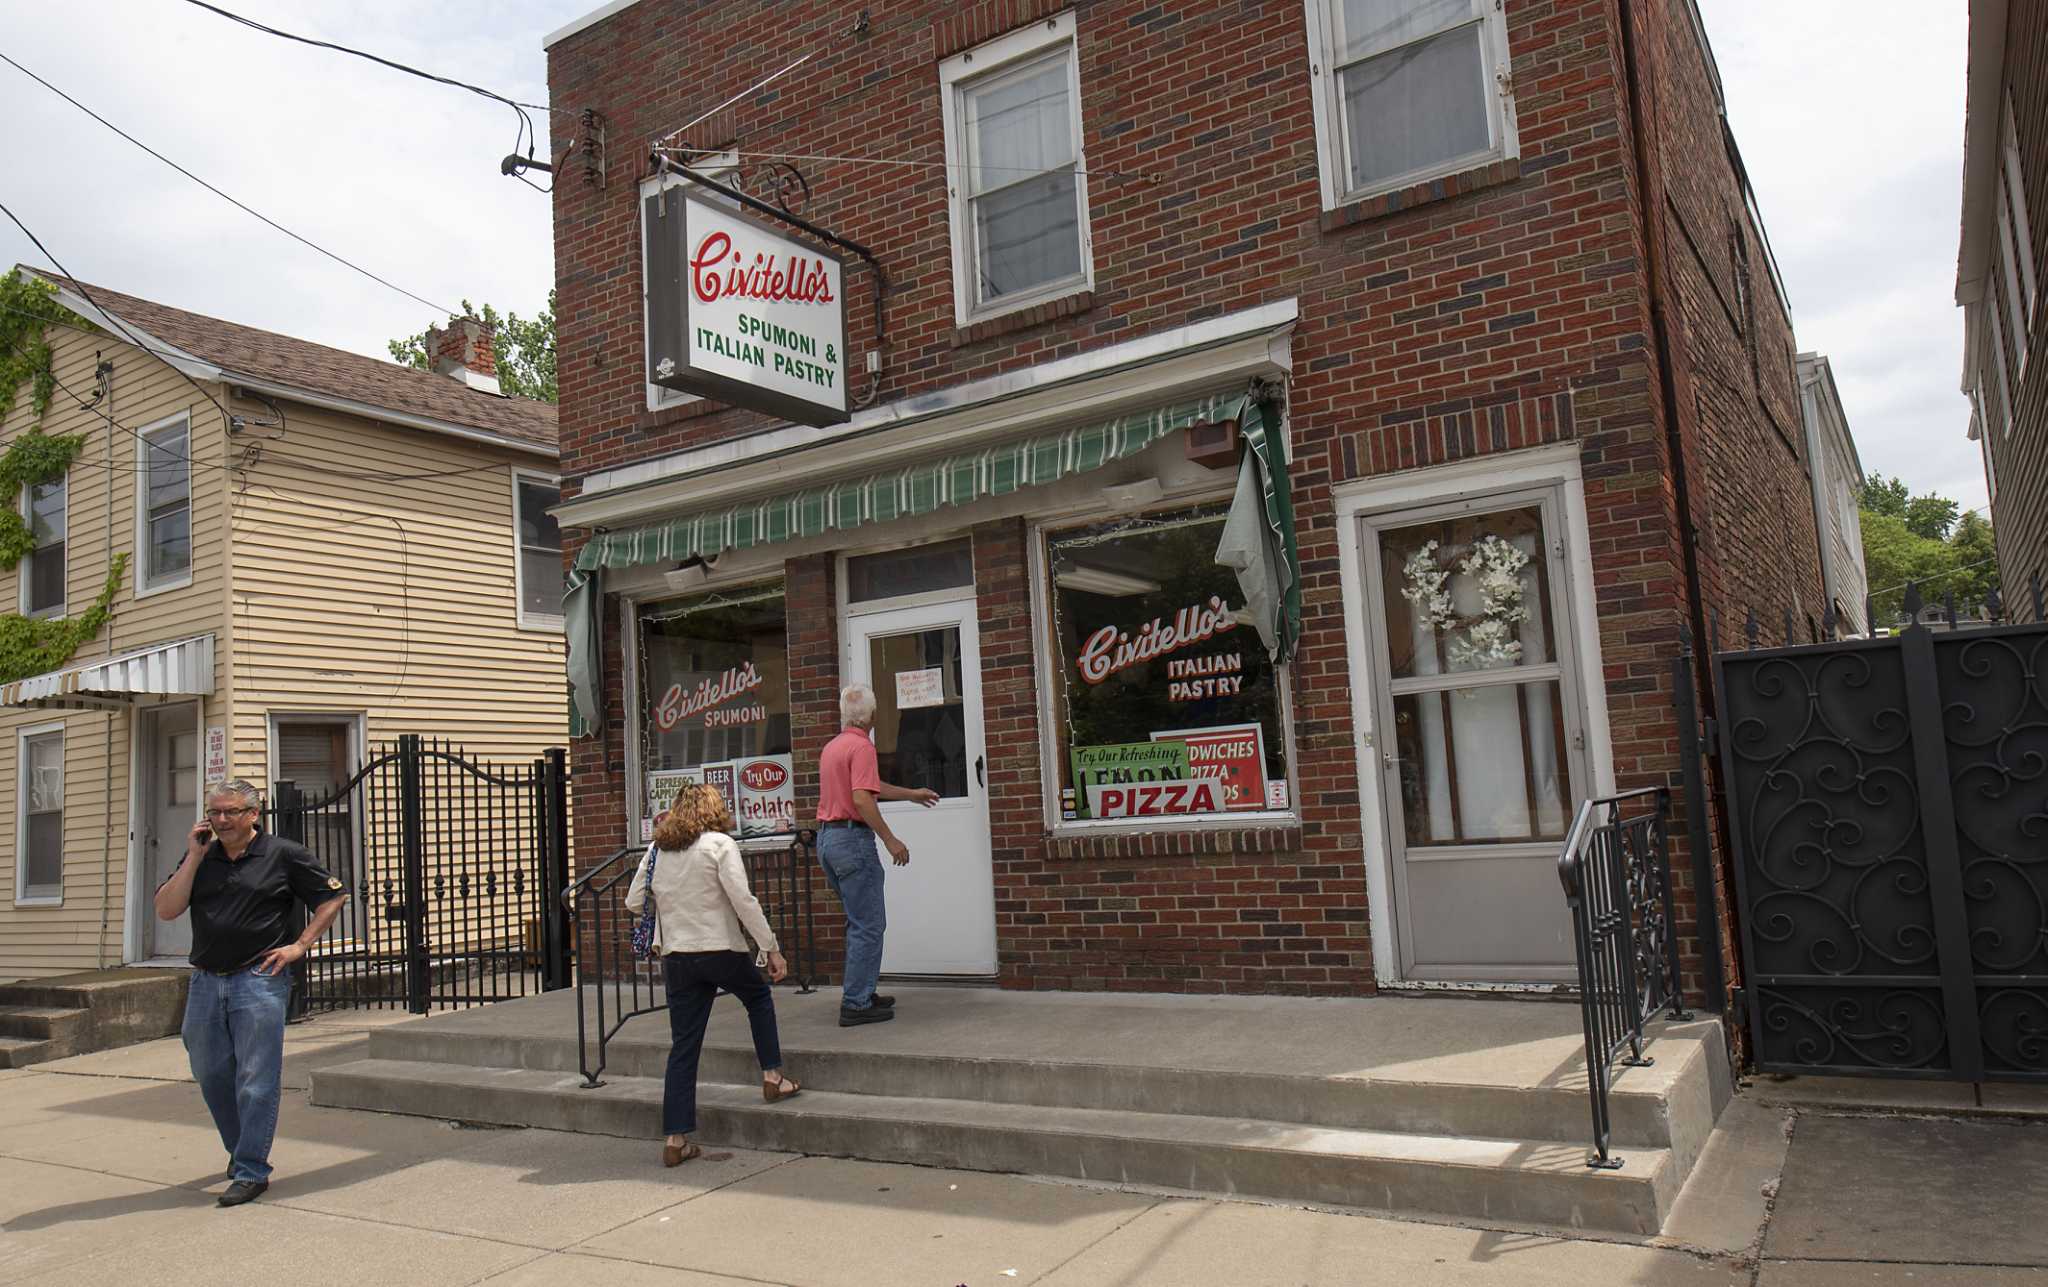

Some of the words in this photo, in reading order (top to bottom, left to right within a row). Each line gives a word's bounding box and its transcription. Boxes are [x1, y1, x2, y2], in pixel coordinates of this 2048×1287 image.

[690, 231, 834, 302] Civitello's
[738, 313, 817, 357] SPUMONI
[825, 343, 837, 364] &
[697, 327, 765, 368] ITALIAN
[774, 352, 835, 388] PASTRY
[1077, 596, 1238, 683] Civitello's
[1168, 653, 1242, 678] ITALIAN
[656, 661, 763, 731] Civitello's
[1168, 676, 1243, 701] PASTRY
[704, 705, 767, 728] SPUMONI
[1077, 749, 1096, 765] Try
[1098, 749, 1119, 761] Our
[1120, 746, 1181, 764] Refreshing
[1187, 741, 1255, 761] DWICHES
[707, 770, 730, 784] BEER
[745, 769, 763, 786] Try
[763, 768, 783, 782] Our
[1190, 764, 1229, 779] PIZZA
[741, 796, 794, 819] Gelato
[1101, 784, 1216, 816] PIZZA
